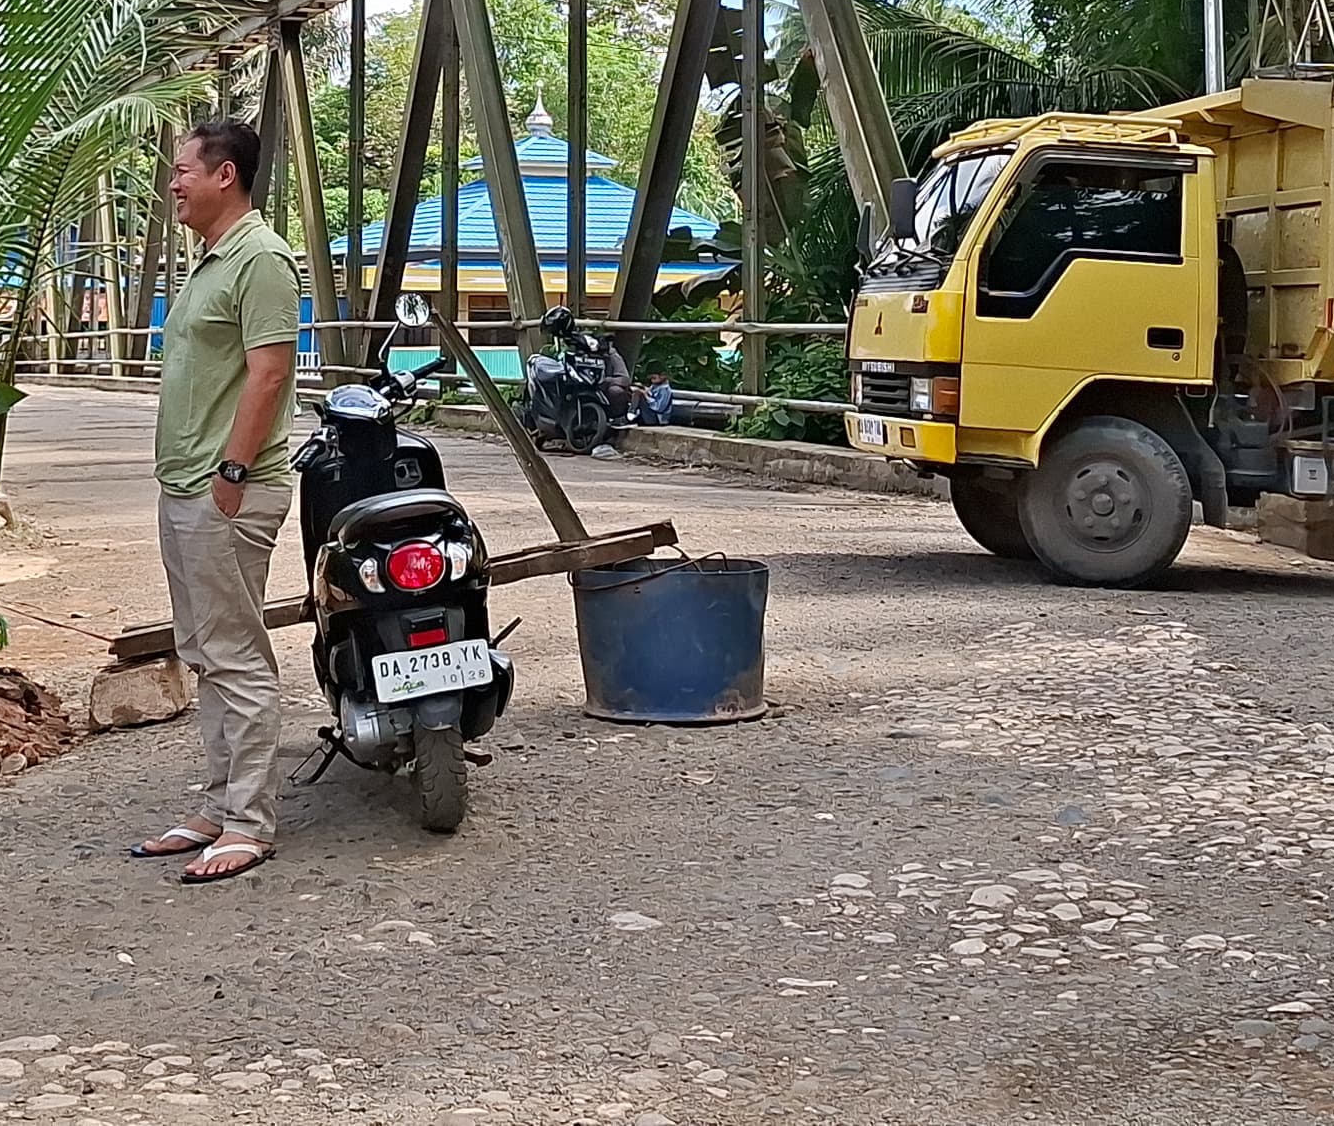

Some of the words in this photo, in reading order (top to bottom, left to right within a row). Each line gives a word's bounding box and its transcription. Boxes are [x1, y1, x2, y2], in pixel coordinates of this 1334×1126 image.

[380, 660, 401, 677] DA
[409, 652, 451, 673] 2738
[461, 645, 483, 662] YK
